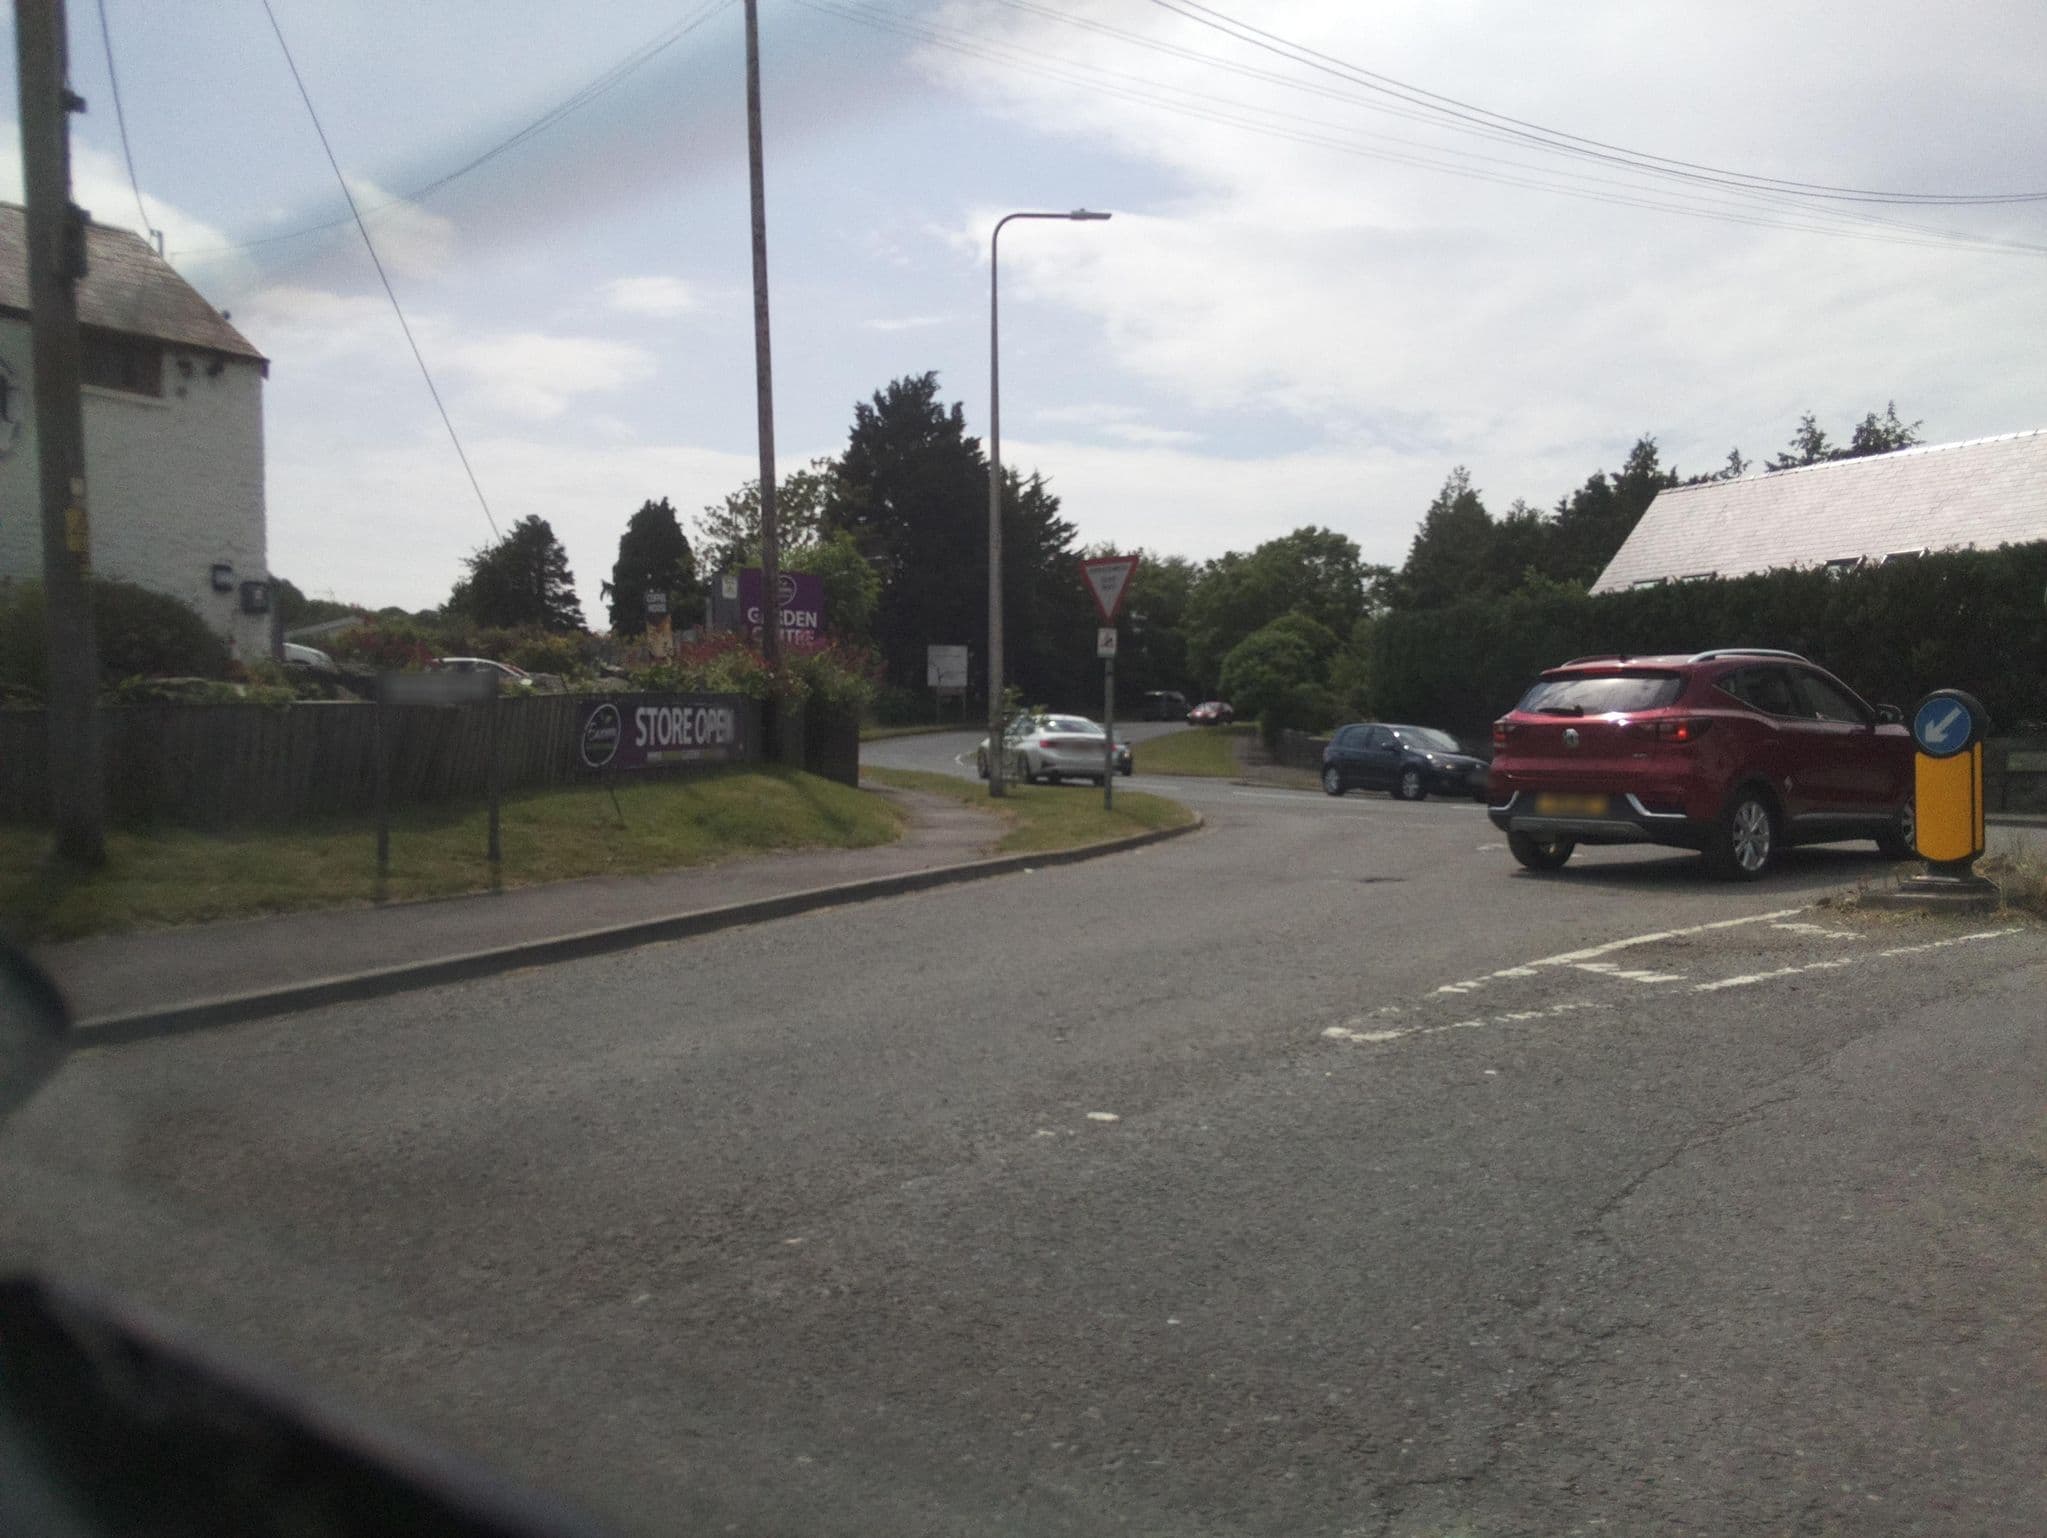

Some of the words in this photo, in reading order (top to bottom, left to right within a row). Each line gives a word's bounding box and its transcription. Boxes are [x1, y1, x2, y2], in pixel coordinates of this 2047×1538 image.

[747, 606, 818, 628] GDEN
[635, 706, 692, 747] STORE
[695, 707, 735, 745] OPEN
